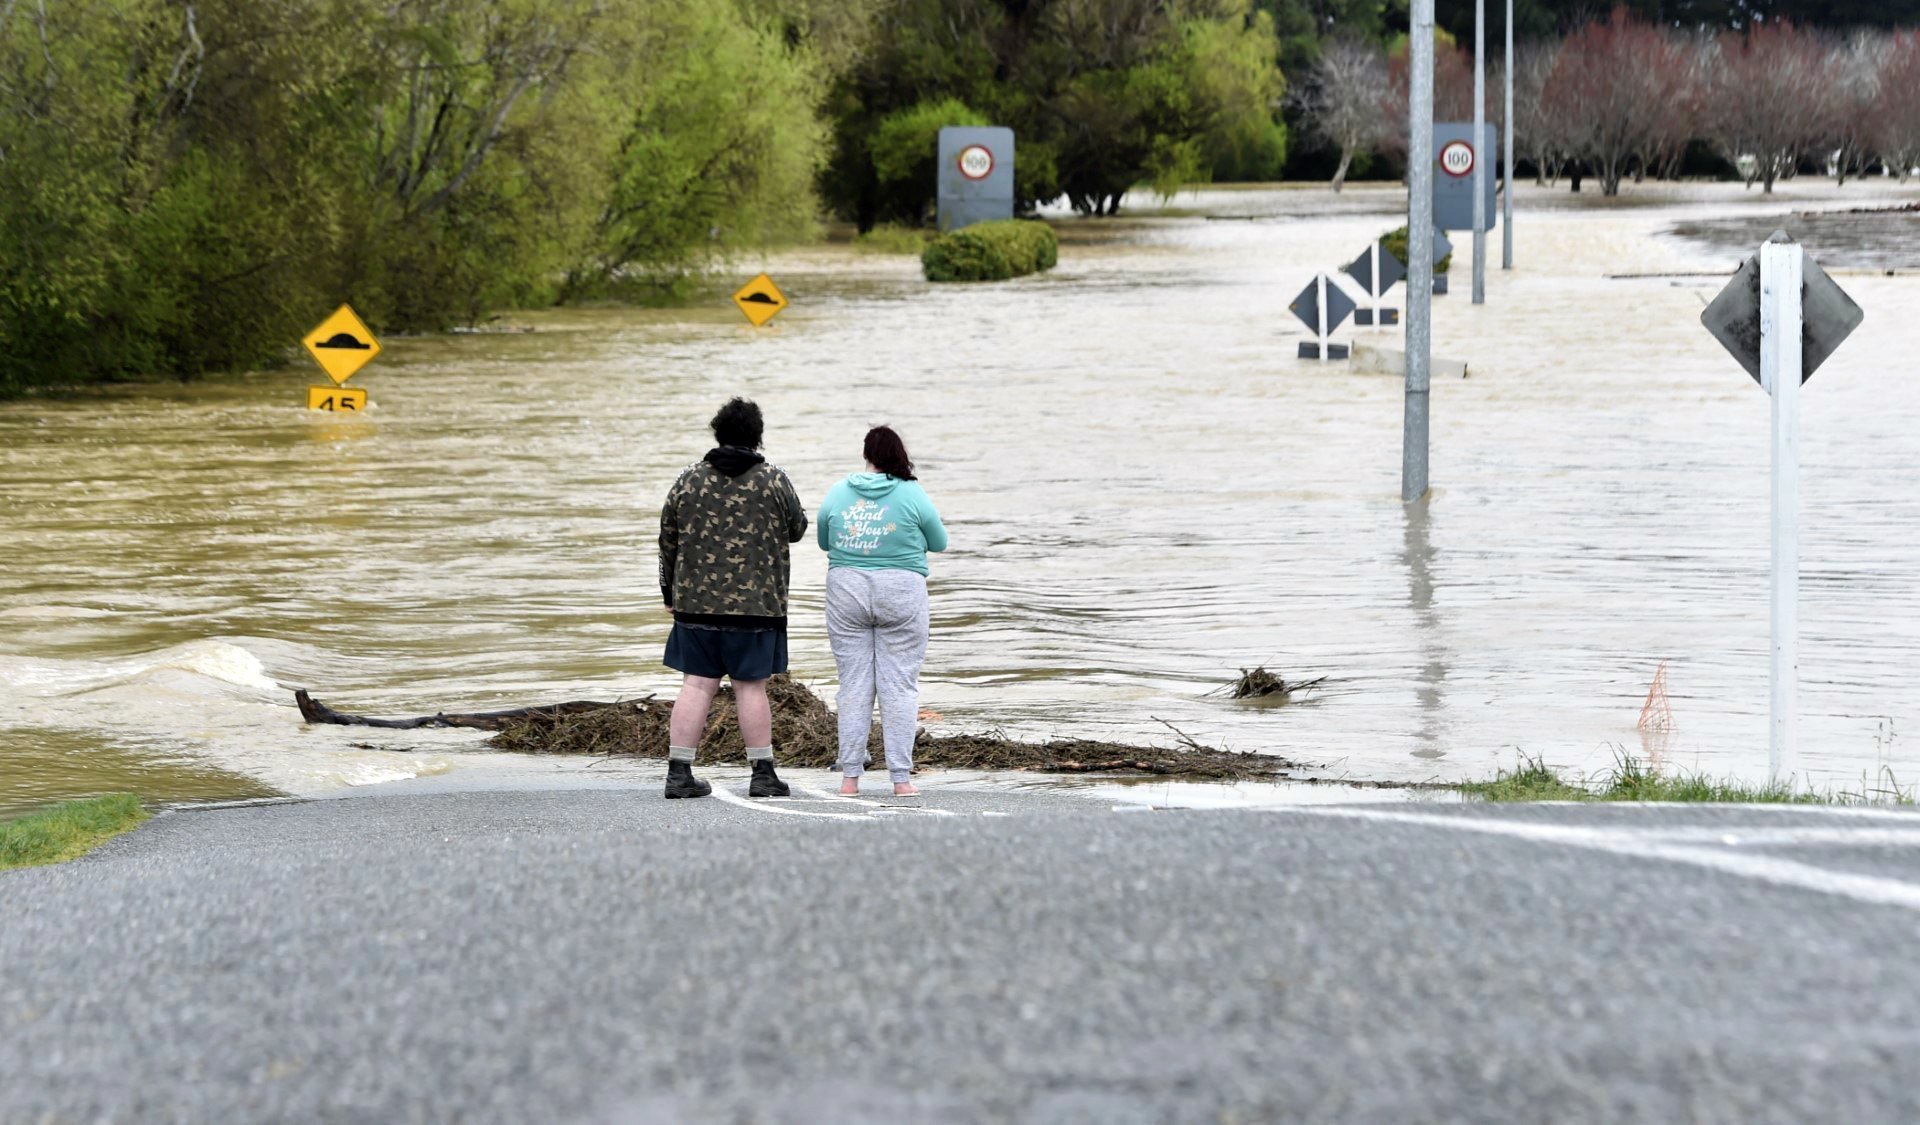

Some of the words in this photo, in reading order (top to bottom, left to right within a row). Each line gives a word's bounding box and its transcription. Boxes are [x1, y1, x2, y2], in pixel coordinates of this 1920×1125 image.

[964, 156, 987, 170] 100
[1447, 151, 1469, 166] 100
[319, 396, 355, 411] 45
[844, 505, 885, 521] Kind
[855, 520, 889, 537] Your
[836, 535, 879, 549] Mind
